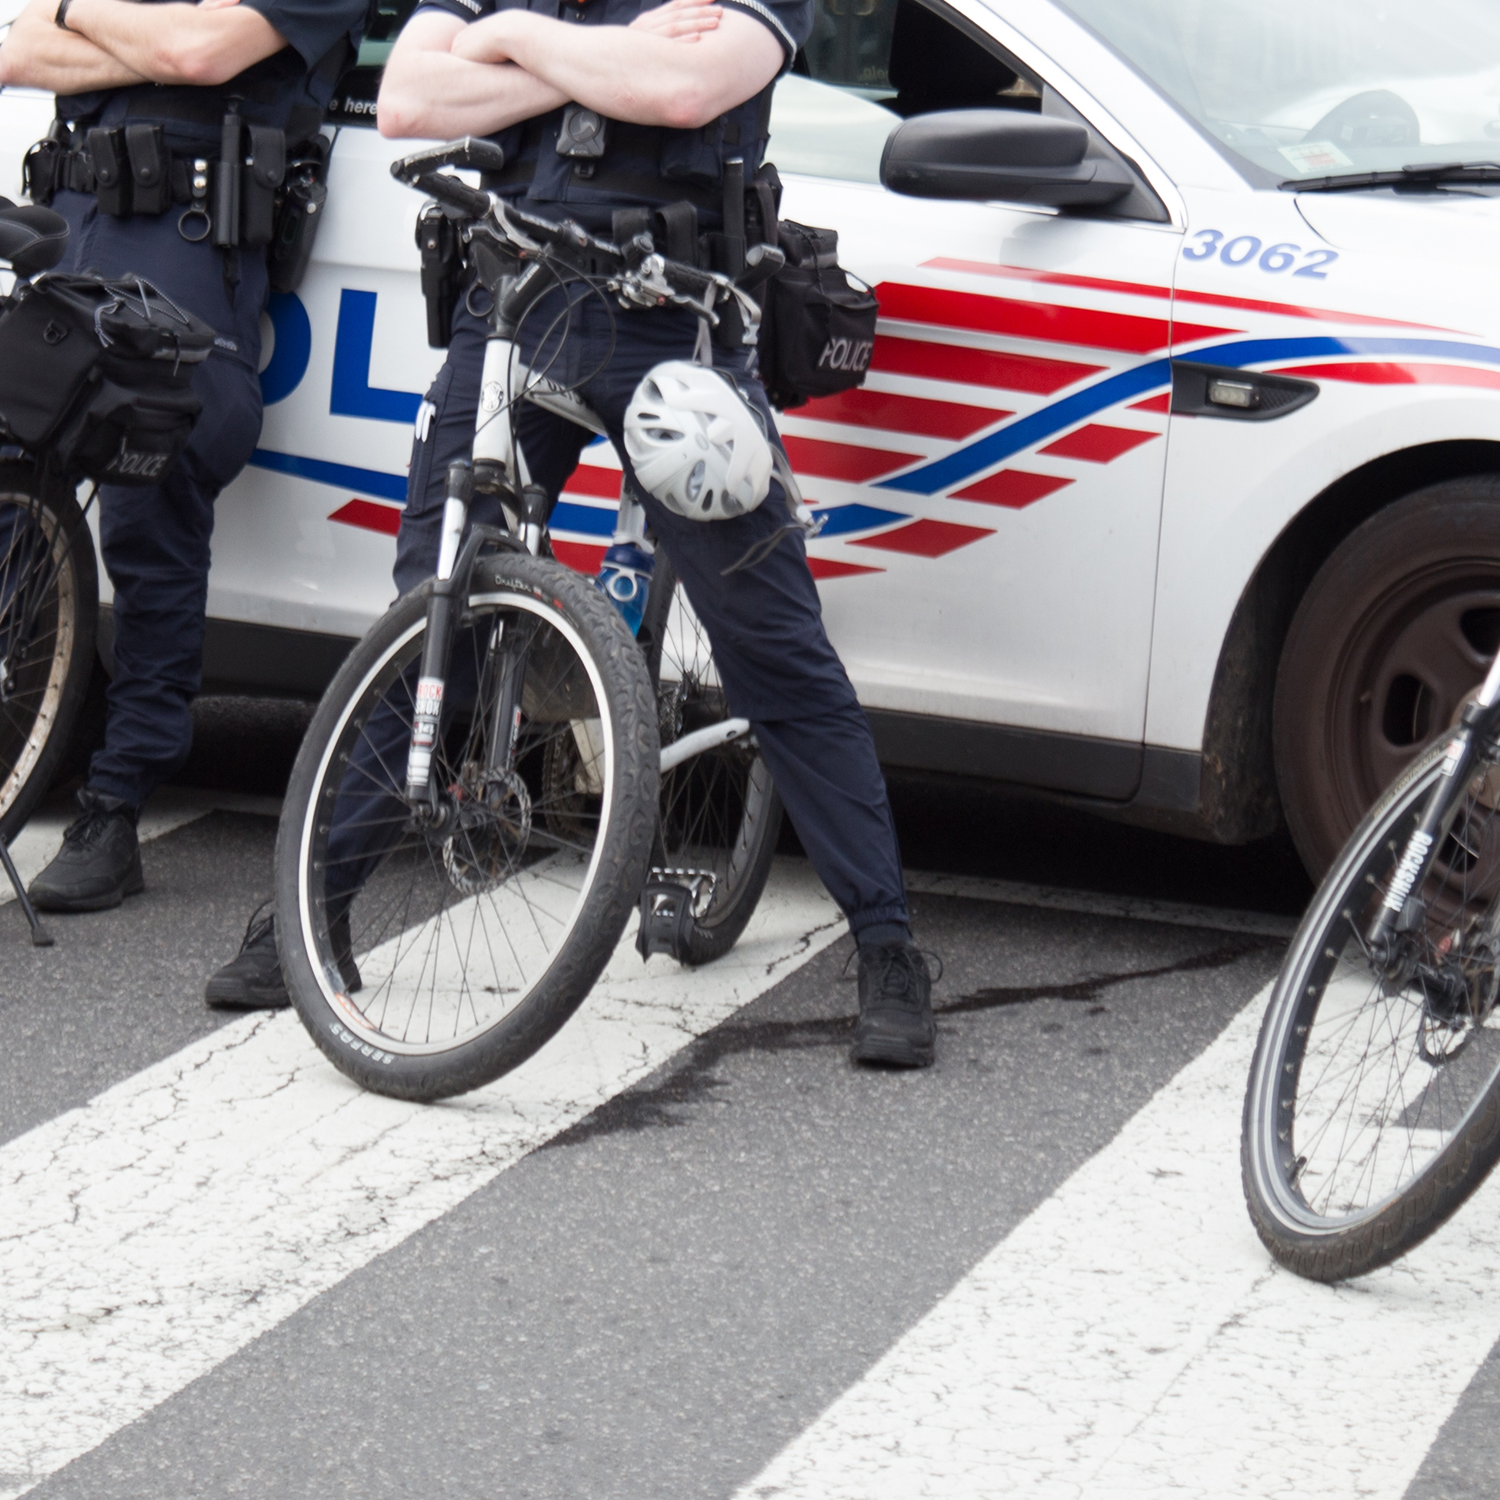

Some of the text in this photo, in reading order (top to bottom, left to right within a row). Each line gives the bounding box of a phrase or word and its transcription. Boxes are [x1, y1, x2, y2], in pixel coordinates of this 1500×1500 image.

[344, 97, 377, 116] here
[1182, 228, 1340, 281] 3062
[818, 337, 874, 372] POLICE
